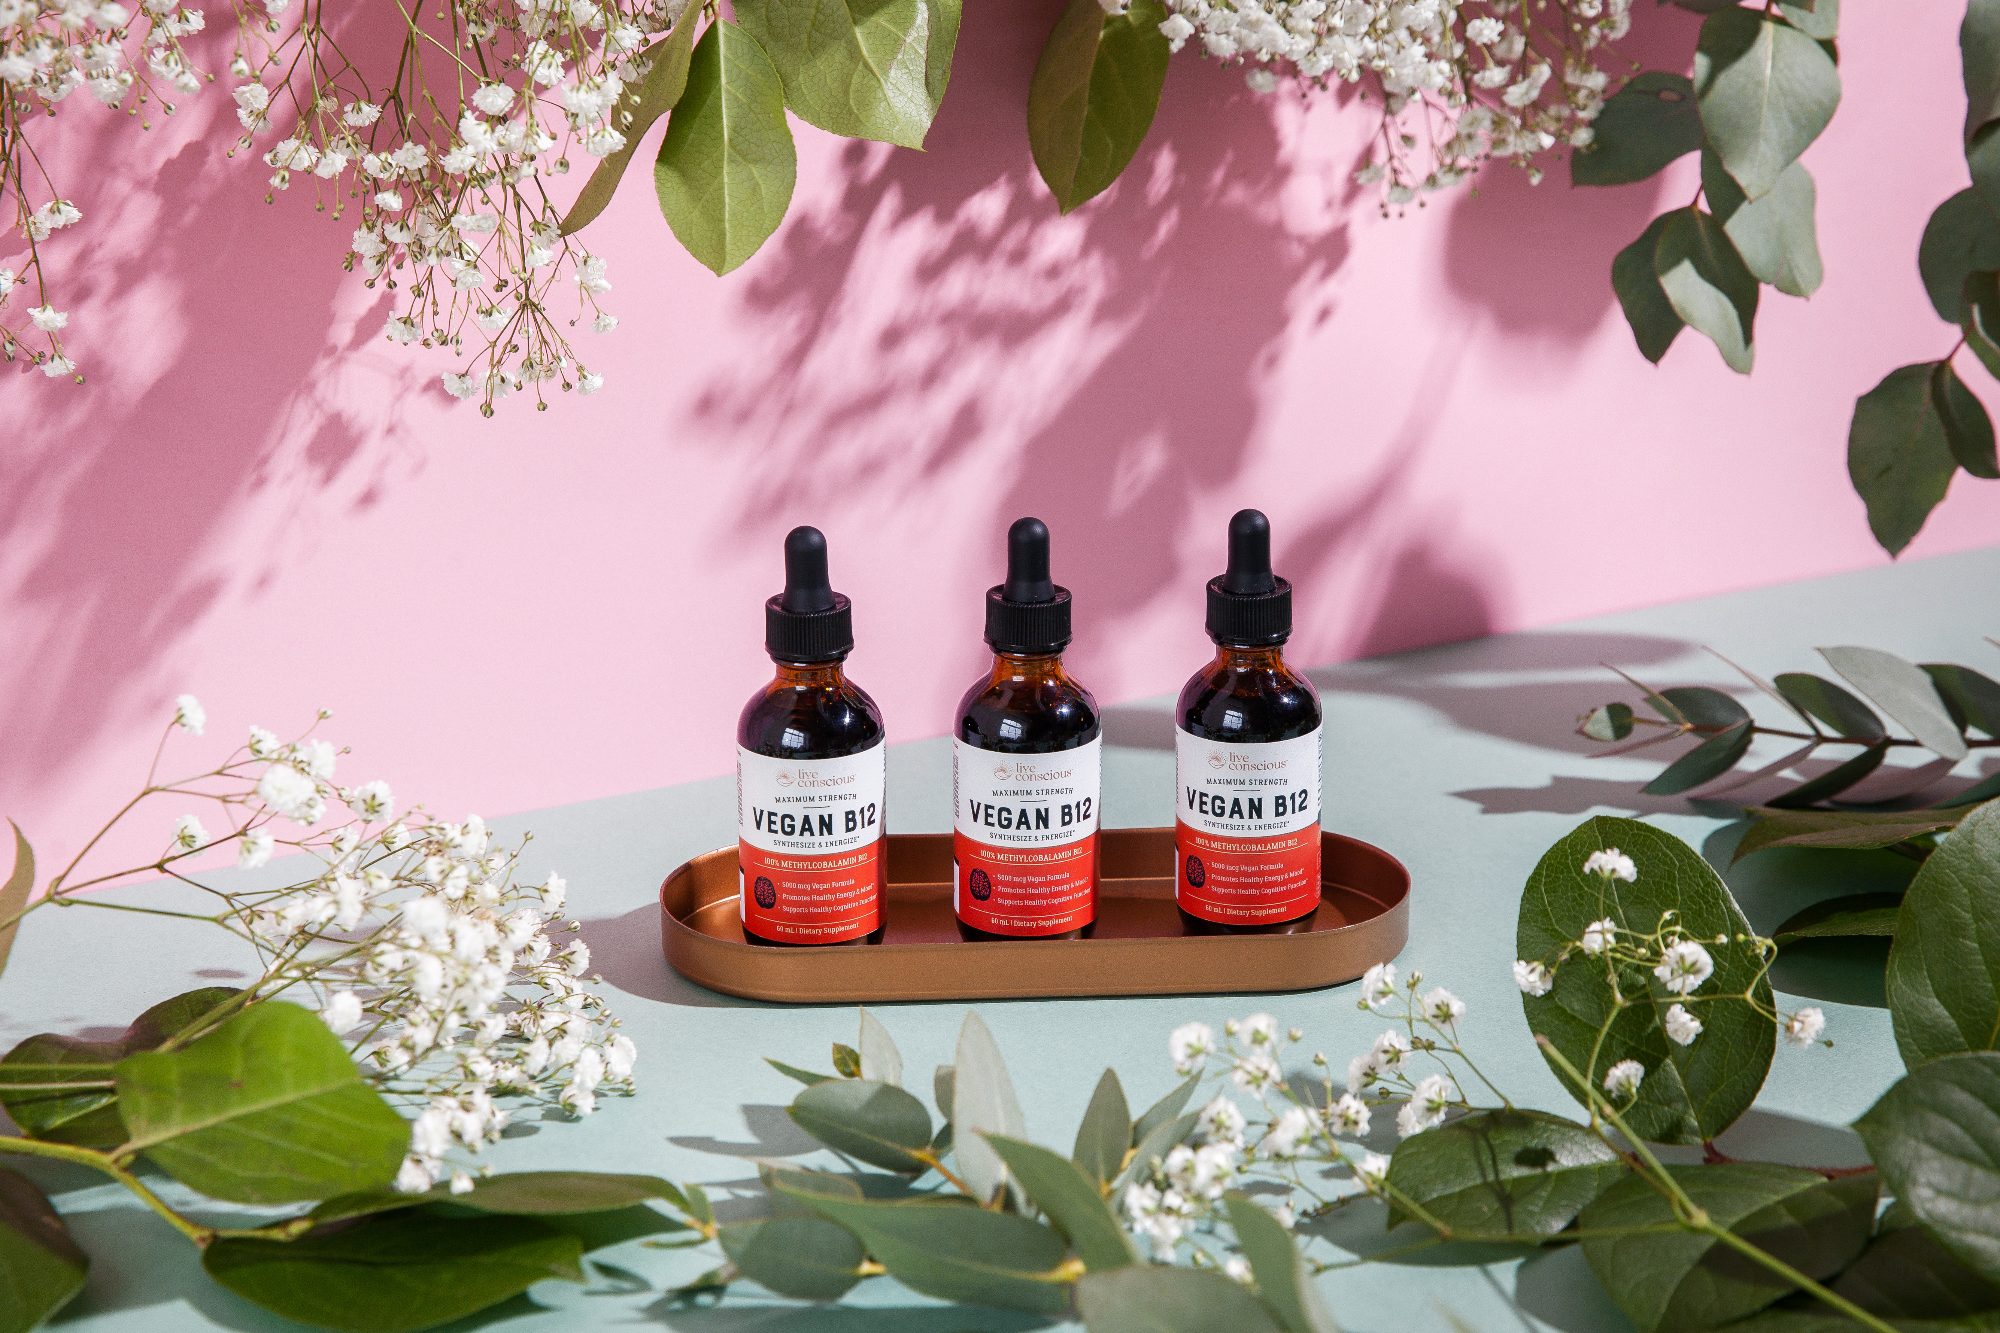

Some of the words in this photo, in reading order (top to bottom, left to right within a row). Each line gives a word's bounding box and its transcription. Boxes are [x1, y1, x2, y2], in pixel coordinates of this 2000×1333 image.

[1229, 752, 1249, 762] live
[1016, 763, 1036, 773] live
[1228, 761, 1286, 771] conscious
[798, 769, 818, 779] live
[1015, 770, 1072, 781] conscious
[798, 776, 855, 787] conscious
[1036, 788, 1073, 796] STRENGTH
[1186, 786, 1262, 819] VEGAN
[1275, 788, 1308, 817] B12
[753, 807, 833, 836] VEGAN
[845, 802, 876, 833] B12
[969, 799, 1049, 830] VEGAN
[1061, 797, 1092, 827] B12
[1204, 820, 1244, 830] SYNTHESIZE
[990, 832, 1032, 841] SYNTHESIZE
[774, 840, 815, 848] SYNTHESIZE
[1195, 837, 1209, 846] 100%
[1211, 840, 1286, 851] METHYLCOBALAMIN
[980, 849, 995, 859] 100%
[998, 851, 1072, 862] METHYLCOBALAMIN
[765, 857, 779, 866] 100%
[781, 857, 856, 869] METHYLCOBALAMIN
[998, 898, 1023, 906] Supports
[1227, 908, 1250, 917] Dietary
[1251, 906, 1287, 916] Supplement
[1014, 919, 1037, 927] Dietary
[1038, 916, 1073, 926] Supplement
[800, 928, 822, 936] Dietary
[824, 922, 859, 934] Supplement
